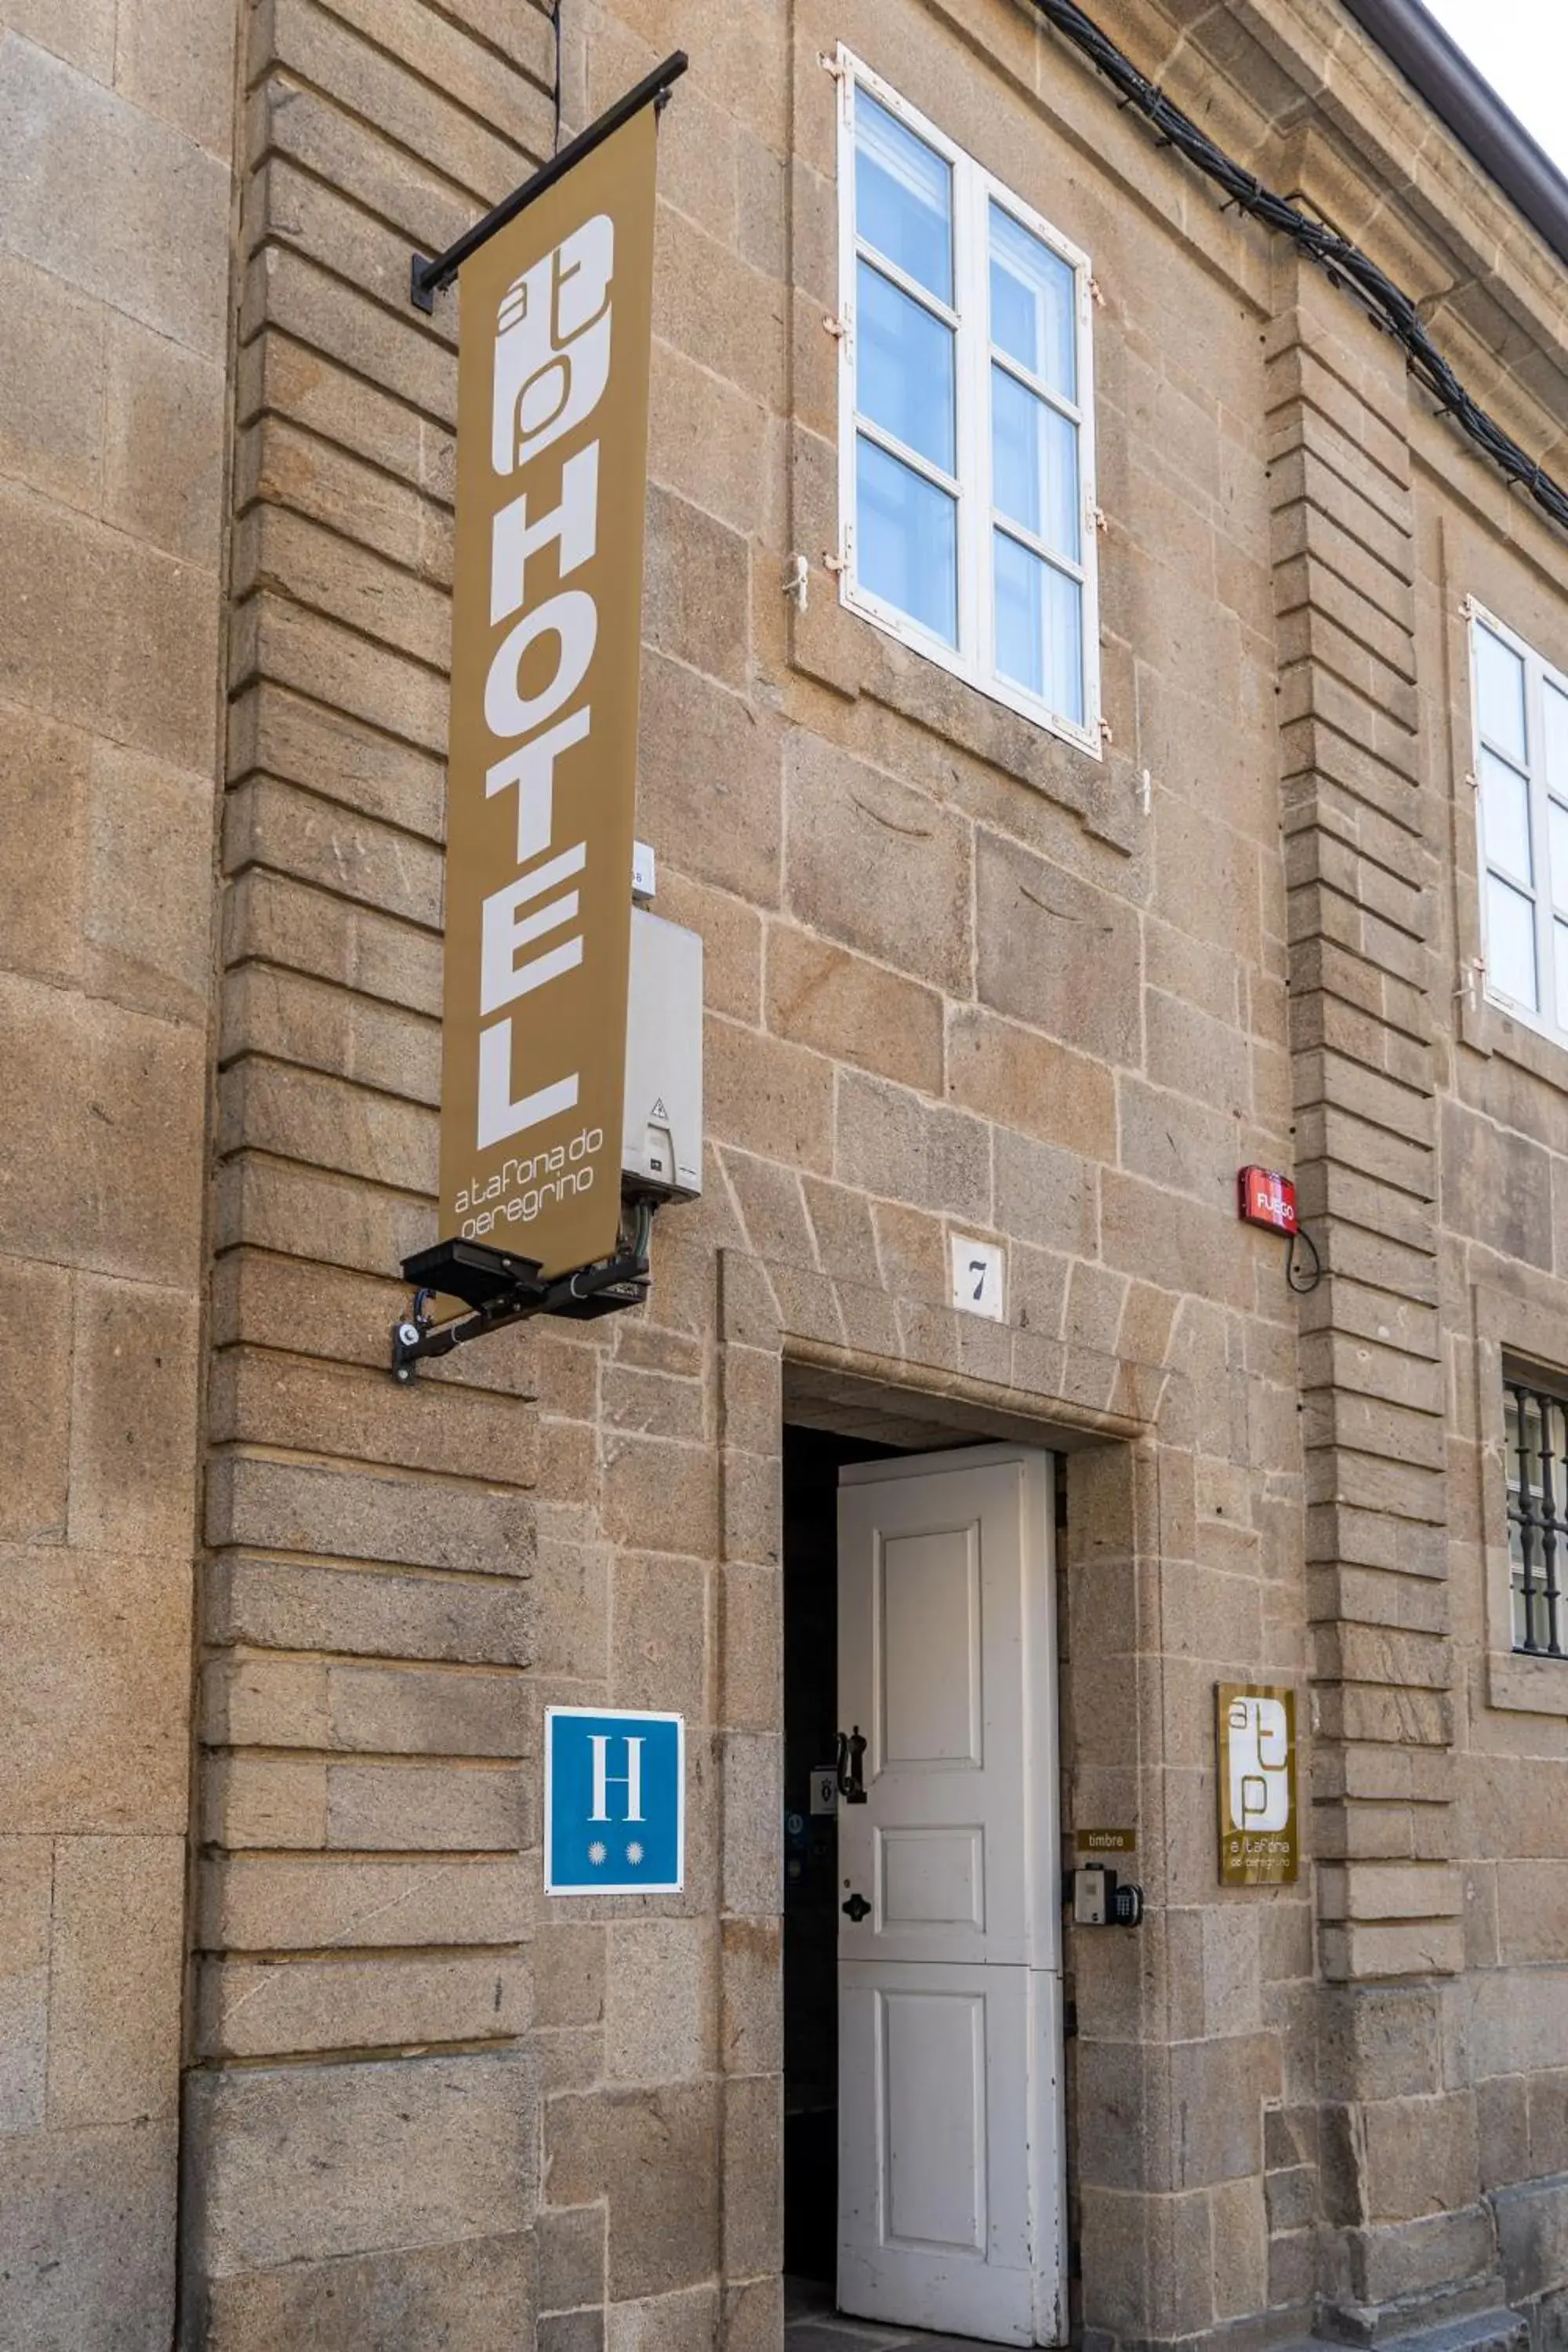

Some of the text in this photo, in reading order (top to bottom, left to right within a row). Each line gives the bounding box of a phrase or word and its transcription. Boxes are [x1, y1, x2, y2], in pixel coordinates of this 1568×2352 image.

[477, 439, 600, 1151] HOTEL
[1256, 1192, 1294, 1221] FUEGO
[968, 1260, 987, 1301] 7
[586, 1735, 647, 1822] H
[1088, 1833, 1124, 1847] timbre
